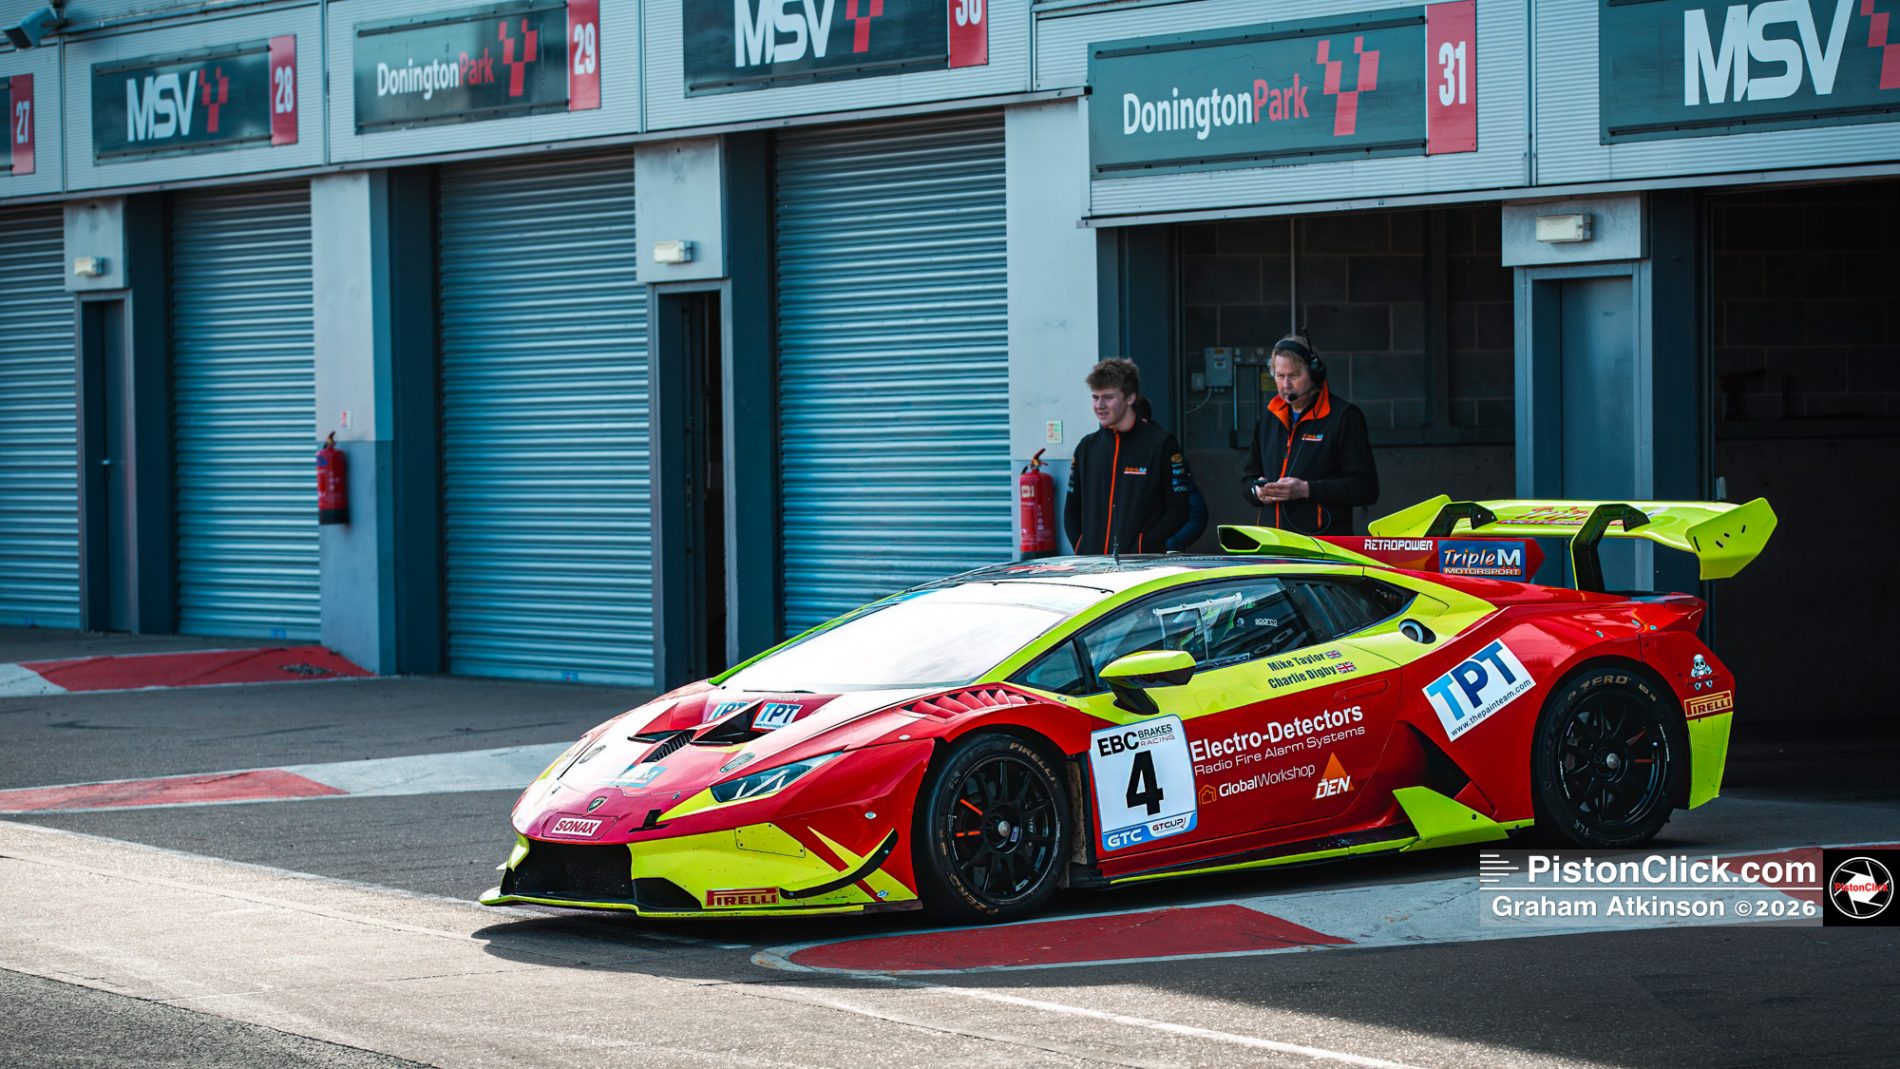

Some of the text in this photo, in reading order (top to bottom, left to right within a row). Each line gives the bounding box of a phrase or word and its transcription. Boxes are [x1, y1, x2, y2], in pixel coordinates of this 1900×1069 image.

[574, 22, 596, 75] 29
[734, 0, 835, 67] MSV
[1684, 0, 1854, 106] MSV
[274, 66, 294, 114] 28
[1438, 41, 1467, 106] 31
[16, 101, 30, 144] 27
[127, 70, 198, 142] MSV
[1364, 539, 1433, 551] RETROPOWER
[1443, 567, 1521, 576] MOTORSPORT
[1267, 652, 1326, 671] Mike Taylor
[1268, 665, 1338, 689] Charlie Digby
[1426, 640, 1517, 721] TPT
[760, 703, 801, 723] TPT
[1450, 679, 1532, 736] www.thepainteam.com
[1685, 691, 1732, 716] PIRELLI
[1097, 723, 1173, 757] EBC BRAKES
[1140, 734, 1175, 747] RACING
[1189, 705, 1364, 762] Electro-Detectors
[1194, 726, 1366, 776] Radio Fire Alarm Systems
[1126, 750, 1164, 816] 4
[1219, 764, 1316, 797] GlobalWorkshop
[1315, 775, 1351, 799] DEN
[555, 820, 599, 834] SONAX
[1107, 828, 1143, 848] GTC
[706, 887, 778, 907] PIRELLI
